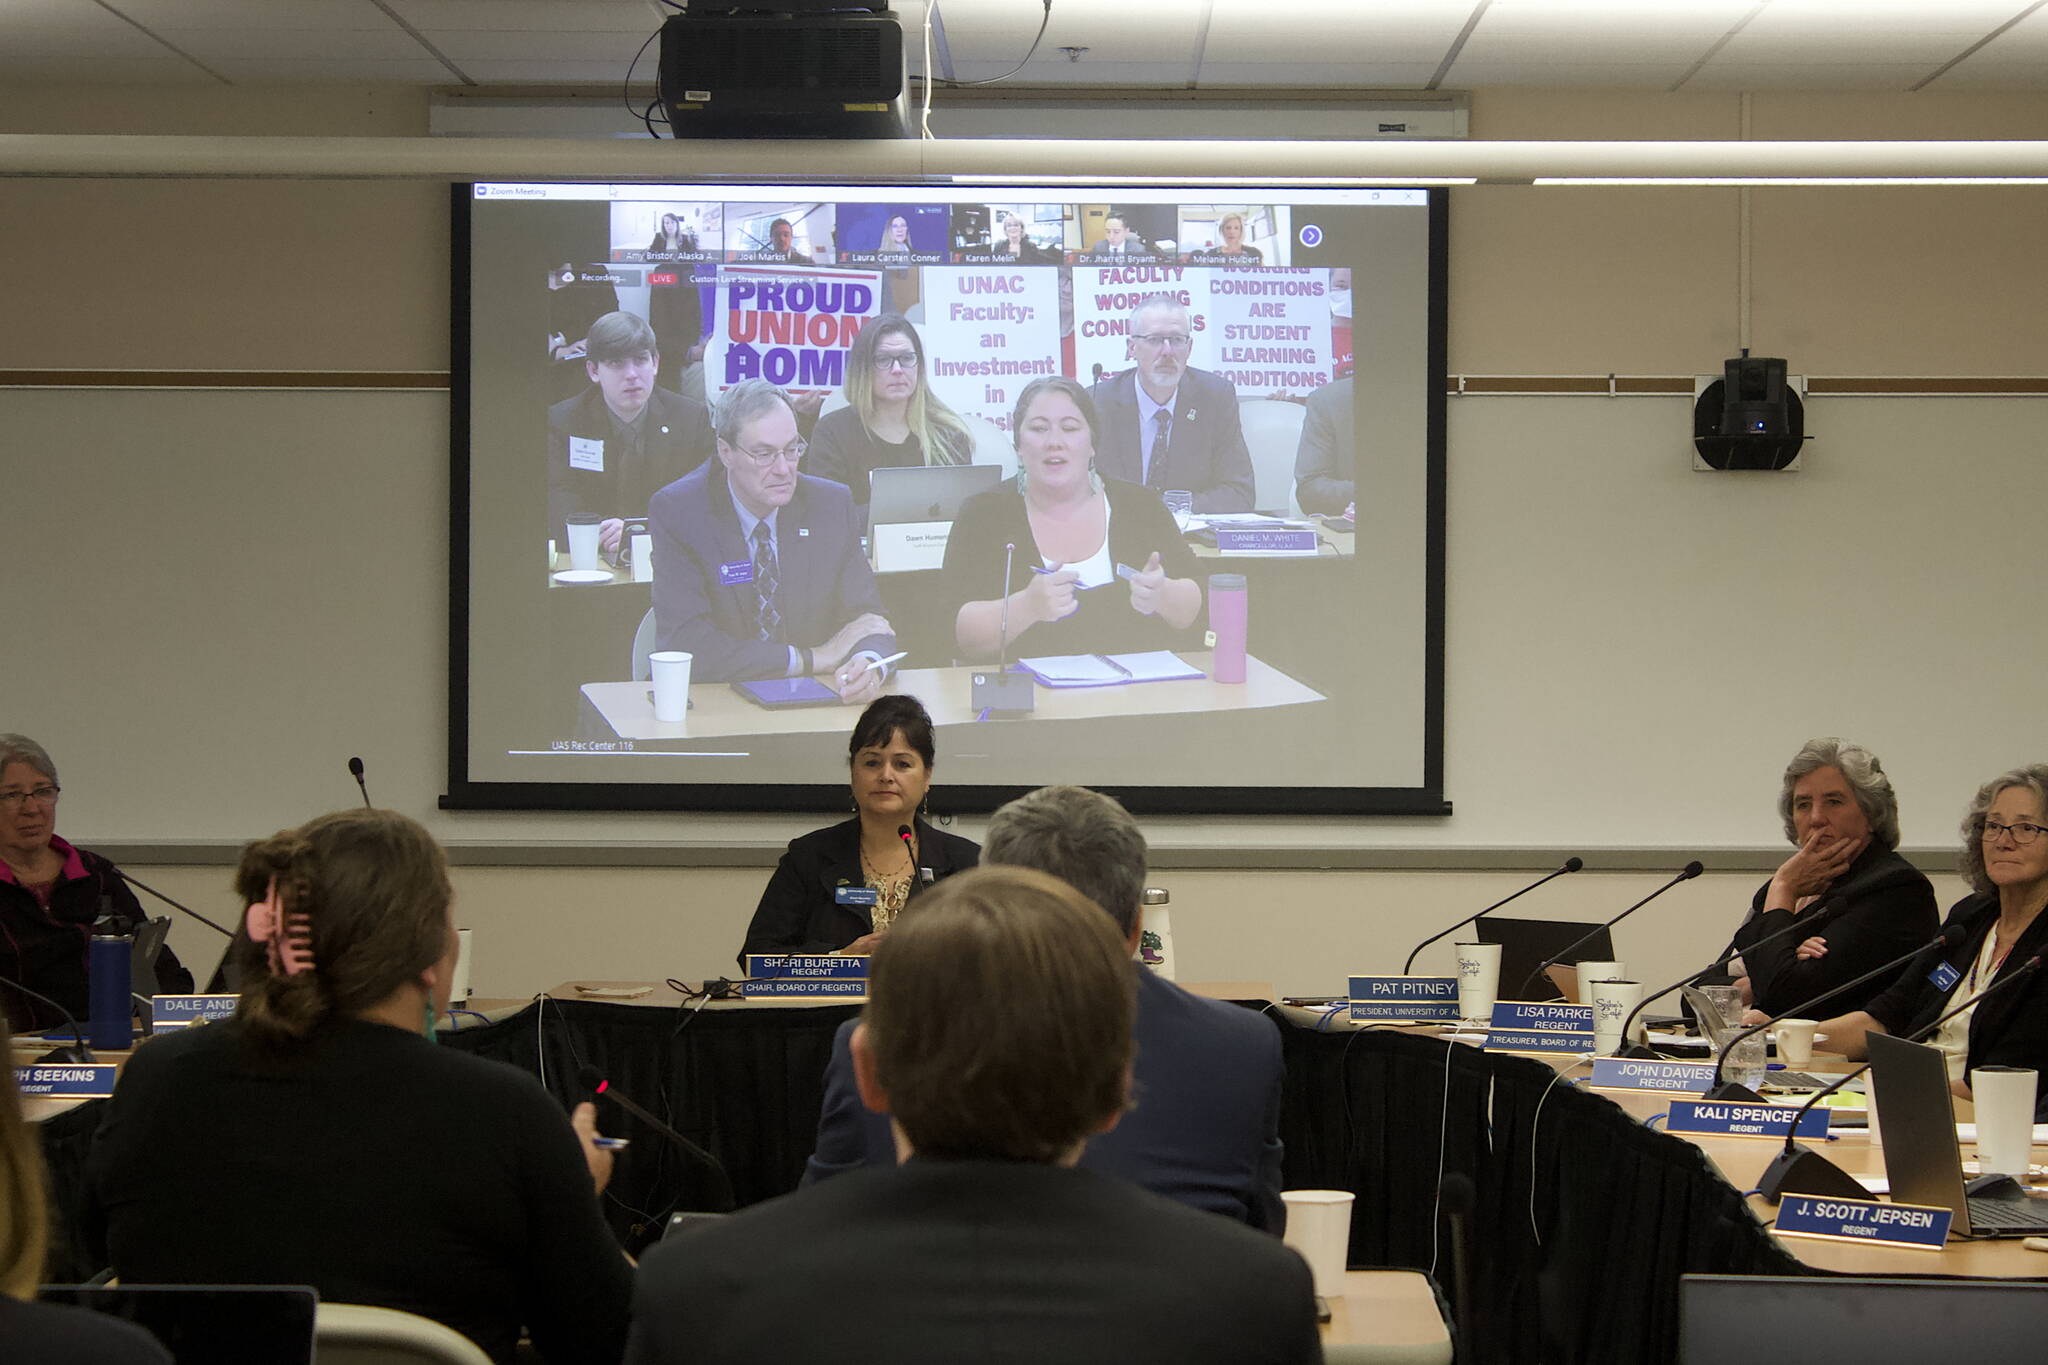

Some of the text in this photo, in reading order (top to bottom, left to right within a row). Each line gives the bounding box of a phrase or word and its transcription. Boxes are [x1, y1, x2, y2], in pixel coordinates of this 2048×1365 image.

[490, 187, 547, 197] Zoom Meeting
[626, 252, 644, 261] Amy
[678, 252, 705, 260] Alaska
[739, 252, 757, 261] Joel
[852, 253, 941, 263] Laura Carsten Conner
[966, 254, 1016, 263] Karen Melin
[1079, 255, 1093, 263] Dr.
[1193, 255, 1260, 265] Melanie Hulbert
[652, 274, 673, 283] LIVE
[689, 274, 718, 284] Custom
[720, 275, 736, 284] Live
[1098, 266, 1184, 285] FACULTY
[957, 275, 1025, 294] UNAC
[1209, 279, 1325, 297] CONDITIONS
[728, 281, 873, 314] PROUD
[1094, 289, 1191, 311] WORNG
[949, 302, 1035, 324] Faculty:
[1248, 302, 1286, 318] ARE
[1224, 323, 1311, 341] STUDENT
[979, 332, 1006, 348] an
[1221, 346, 1316, 364] LEARNING
[724, 342, 854, 387] HOM
[934, 355, 1055, 377] Investment
[984, 383, 1005, 403] in
[1231, 534, 1260, 542] DANIEL
[1274, 534, 1300, 543] WHITE
[551, 741, 634, 751] UAS Rec Center 116
[763, 958, 861, 968] SHERI BURETTA
[791, 968, 833, 976] REGENT
[746, 983, 862, 992] CHAIR, BOARD OF REGENTS
[1372, 982, 1455, 995] PAT PITNEY
[165, 999, 236, 1011] DALE AND
[1352, 1007, 1393, 1016] PRESIDENT,
[1394, 1008, 1438, 1016] UNIVERSITY
[1438, 1008, 1449, 1016] OF
[1516, 1006, 1592, 1020] LISA PARKE
[1534, 1021, 1579, 1031] REGENT
[1541, 1038, 1567, 1047] BOARD
[1569, 1039, 1579, 1047] OF
[33, 1069, 96, 1082] SEEKINS
[1618, 1063, 1714, 1080] JOHN DAVIES
[1639, 1078, 1690, 1090] REGENT
[1694, 1106, 1729, 1120] KALI
[1729, 1124, 1764, 1134] REGENT
[1797, 1201, 1934, 1228] J. SCOTT JEPSEN
[1841, 1224, 1879, 1237] REGENT
